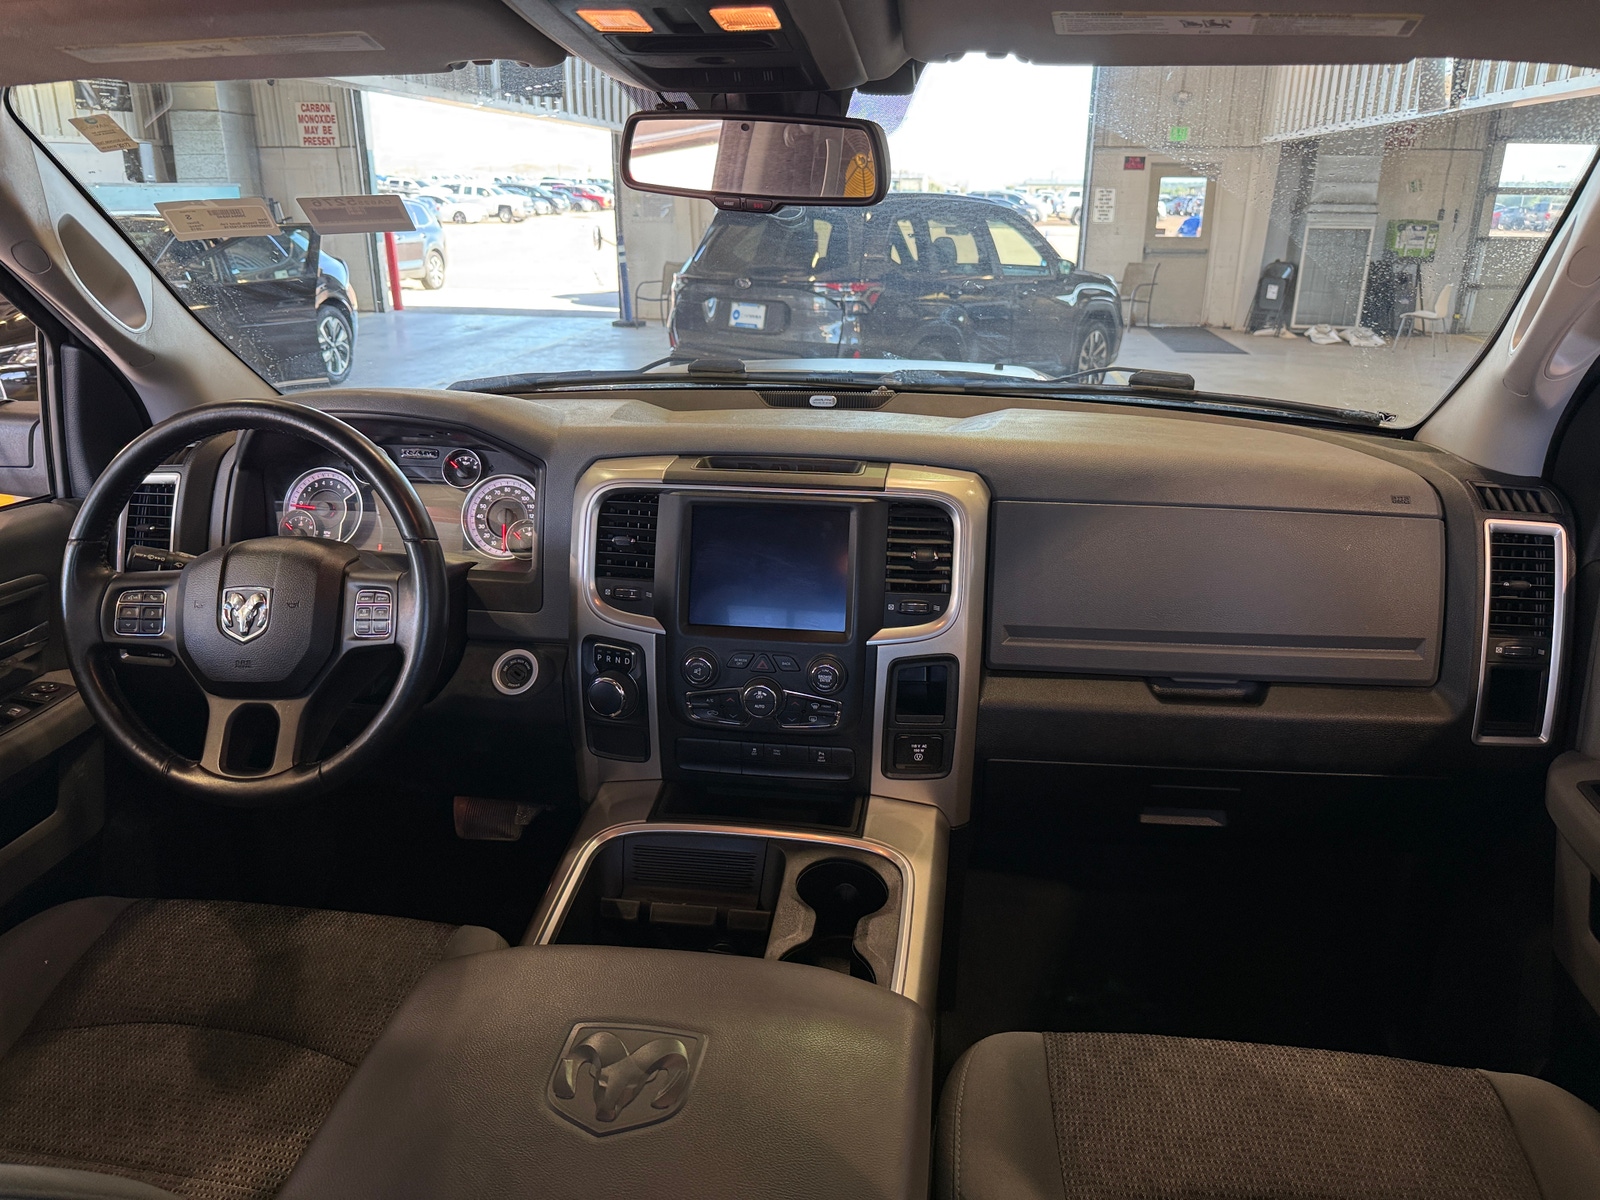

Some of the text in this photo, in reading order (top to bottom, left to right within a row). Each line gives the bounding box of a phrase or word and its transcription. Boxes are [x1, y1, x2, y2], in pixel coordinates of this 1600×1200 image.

[301, 103, 331, 113] CARBON
[297, 114, 336, 124] MONOXIDE
[303, 125, 333, 135] MAY BE
[303, 136, 336, 146] PRESENT
[615, 656, 621, 664] N
[624, 657, 630, 665] D
